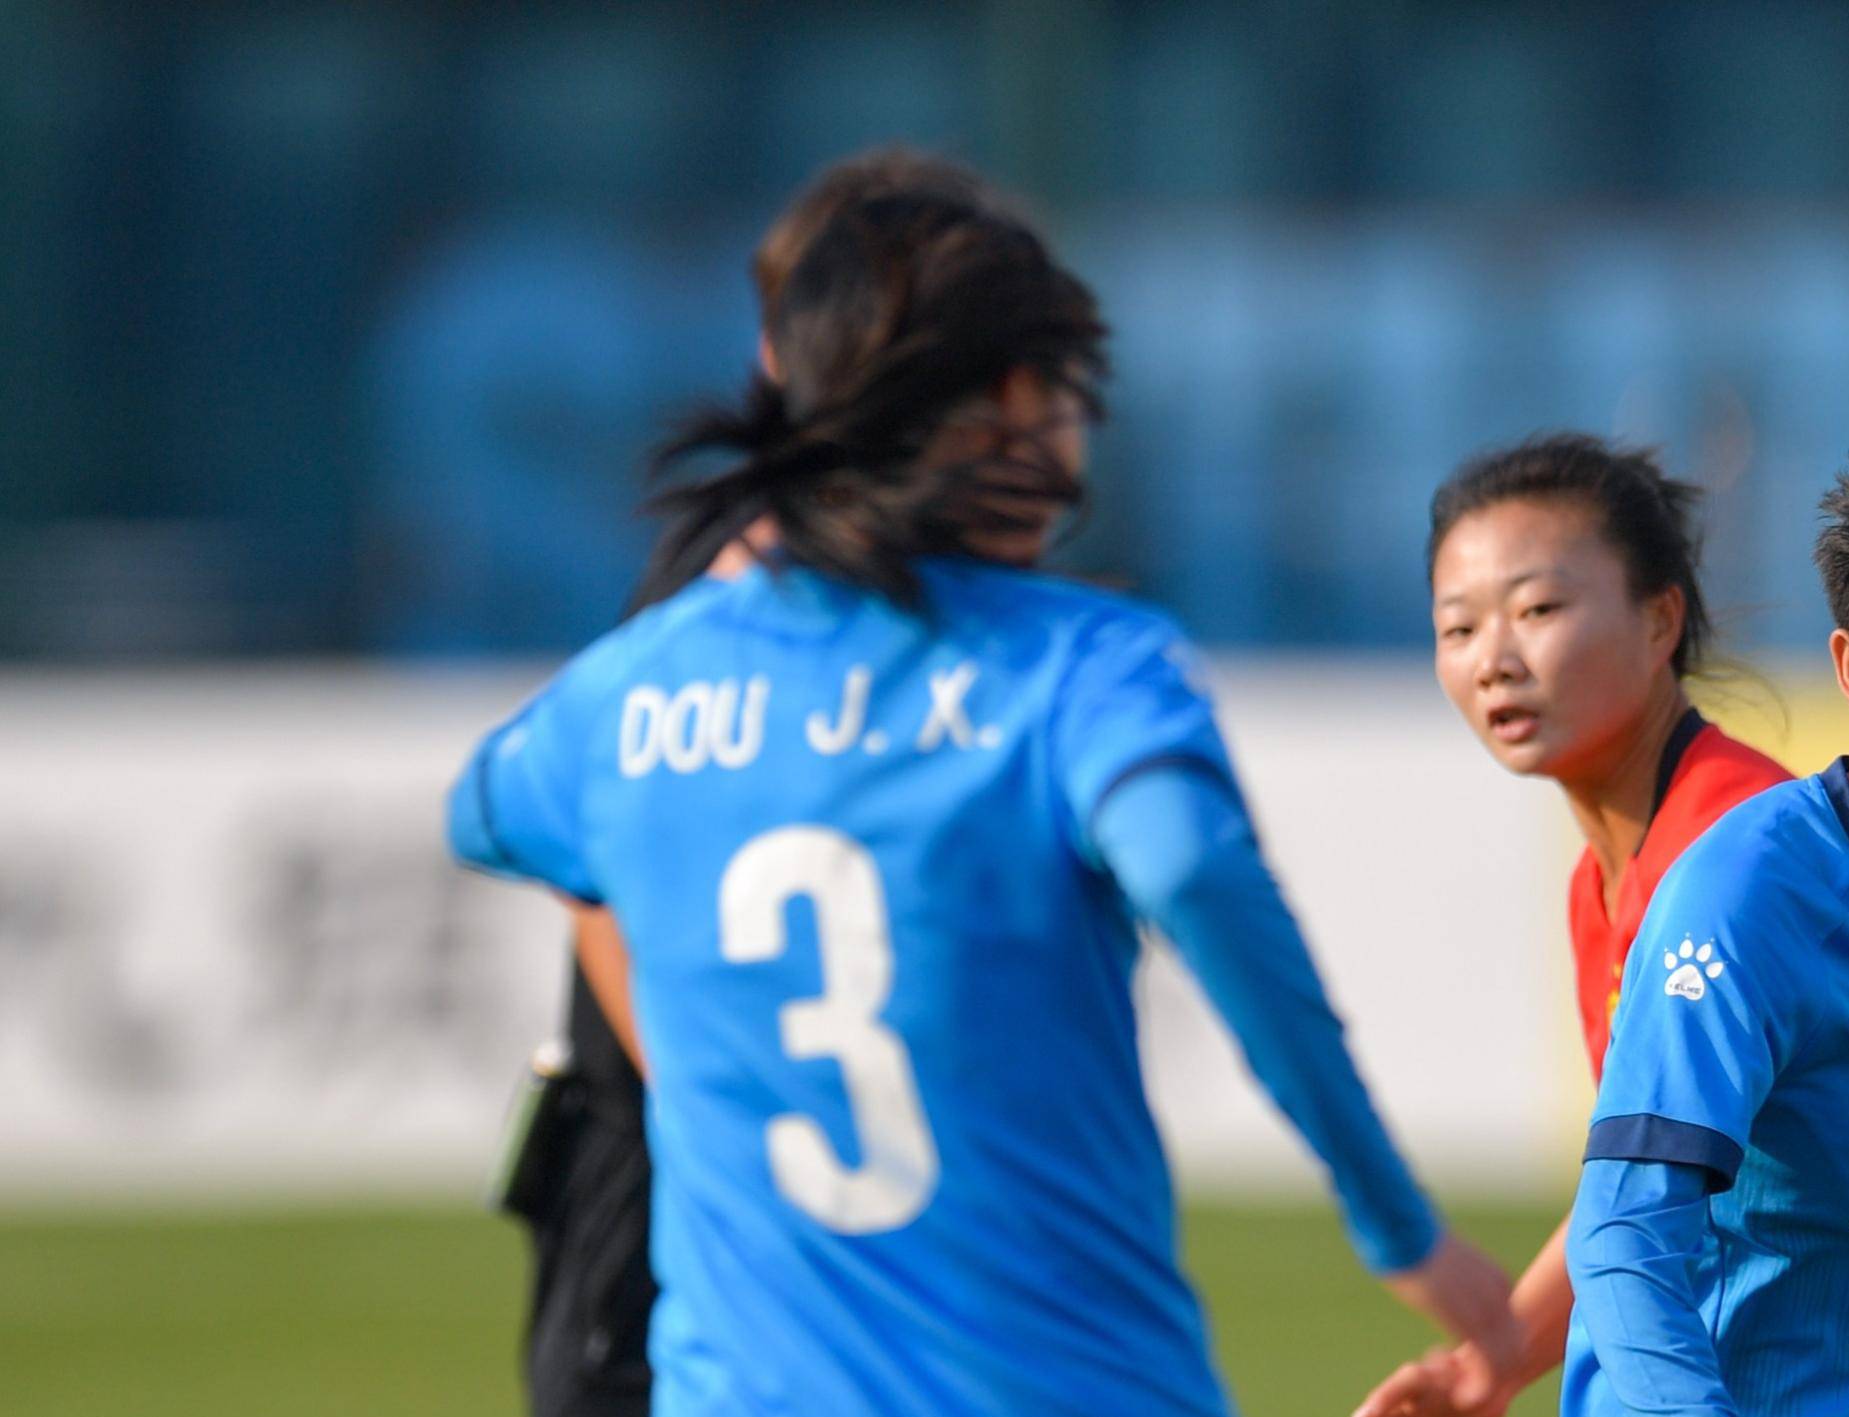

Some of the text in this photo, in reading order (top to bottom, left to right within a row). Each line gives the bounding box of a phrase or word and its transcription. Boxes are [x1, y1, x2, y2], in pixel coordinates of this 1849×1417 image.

[619, 660, 1004, 777] DOU J. X.
[719, 825, 940, 1236] 3
